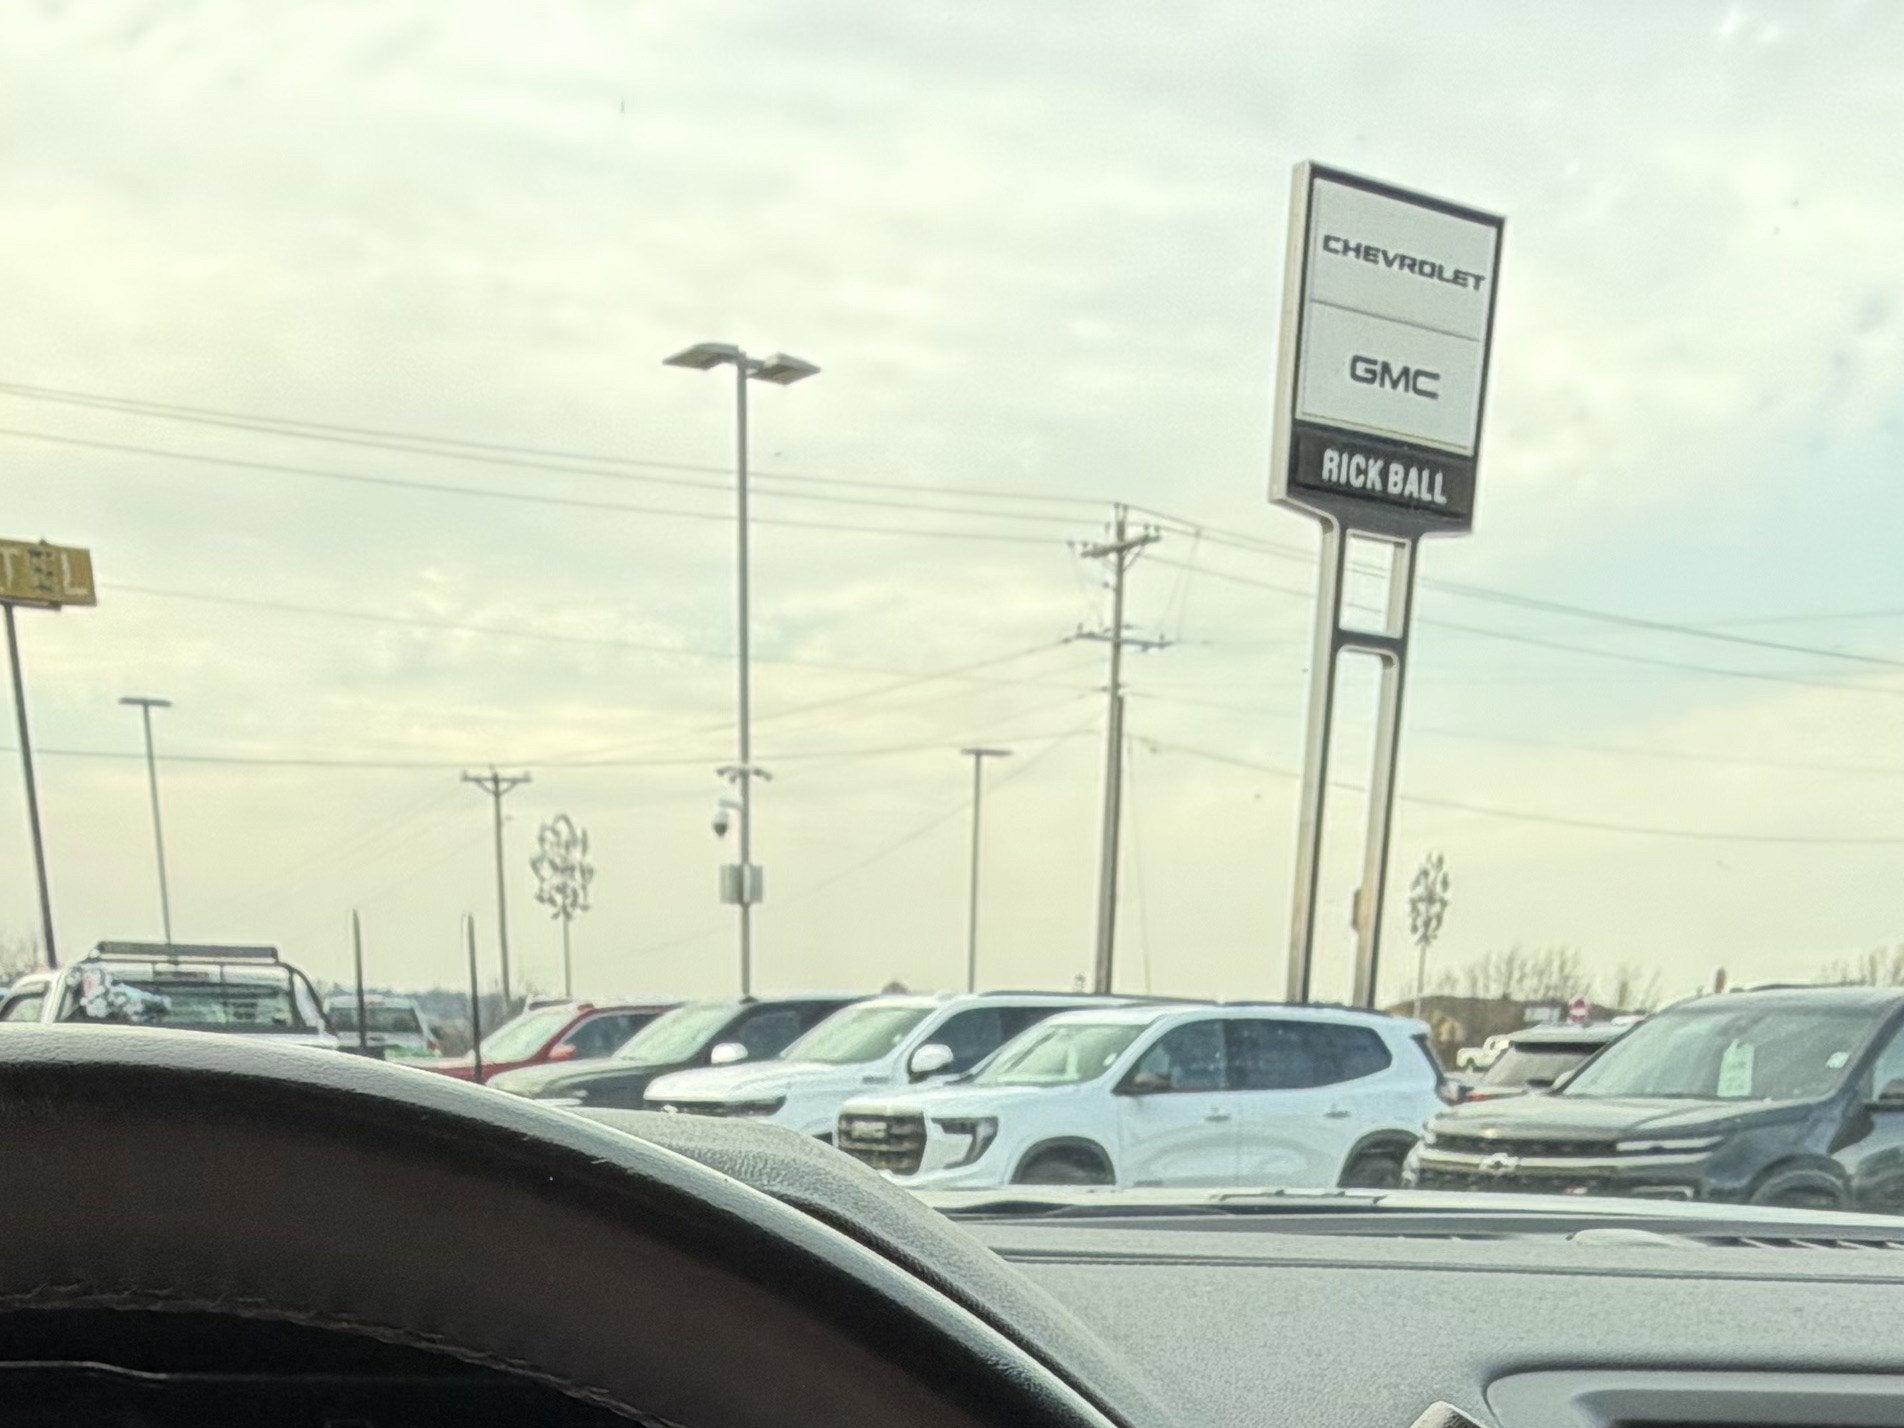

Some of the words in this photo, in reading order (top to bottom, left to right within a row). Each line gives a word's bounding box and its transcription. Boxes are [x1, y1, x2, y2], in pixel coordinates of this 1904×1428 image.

[1323, 234, 1485, 290] CHEVROLET
[1350, 354, 1441, 400] GMC
[1323, 448, 1384, 491] RICK
[1388, 463, 1447, 504] BALL
